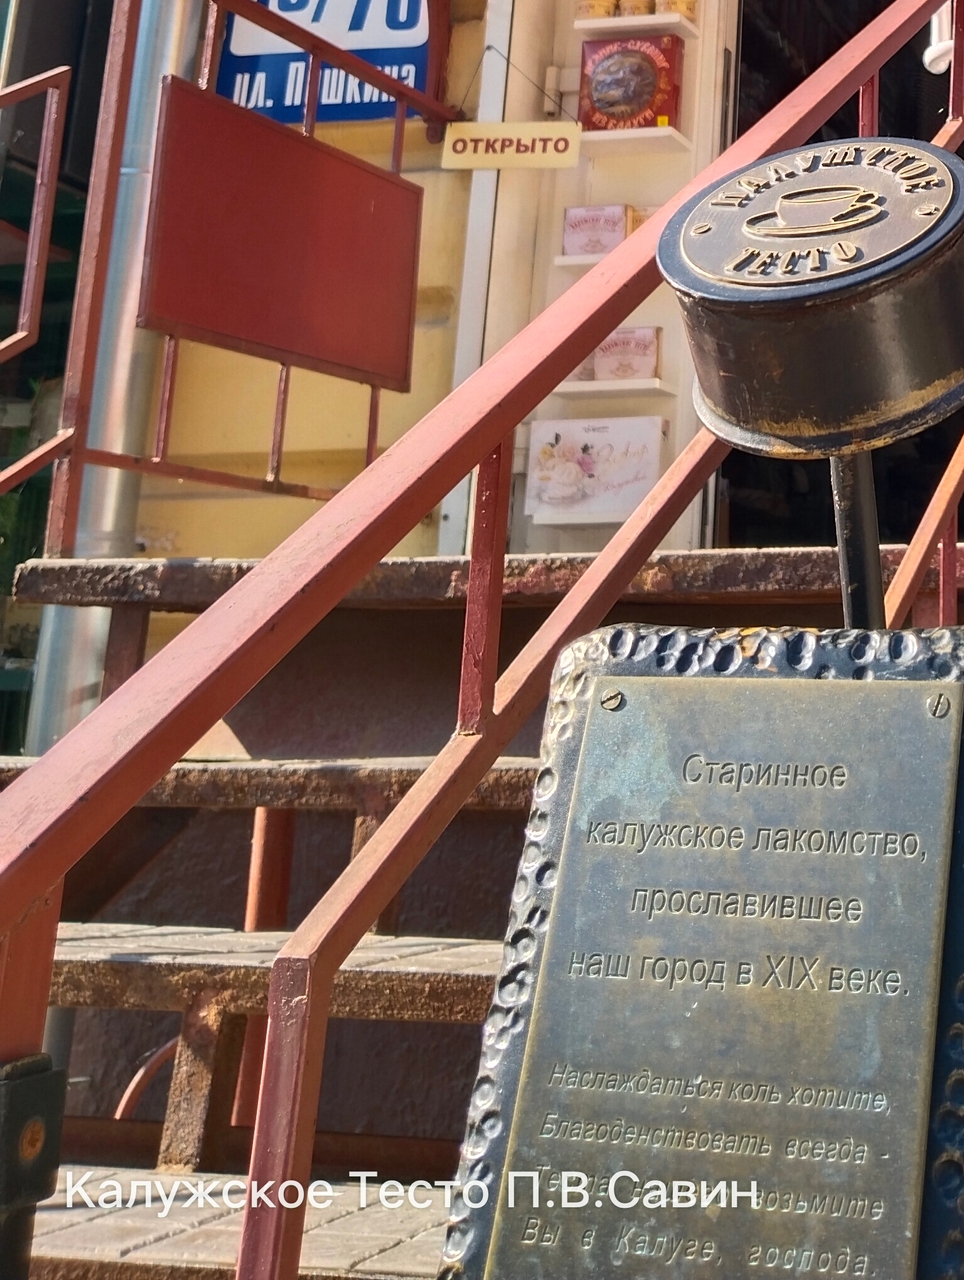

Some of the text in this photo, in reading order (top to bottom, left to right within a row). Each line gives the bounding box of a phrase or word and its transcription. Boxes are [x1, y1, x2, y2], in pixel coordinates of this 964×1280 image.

[284, 62, 417, 108] Пшкина
[452, 136, 570, 156] ОТКРЫТО
[709, 144, 946, 208] КАЛУЖСКОЕ
[724, 239, 859, 275] ТЕСТО
[682, 753, 849, 793] Старинное
[586, 820, 928, 863] калужское лакомство,
[631, 887, 864, 923] прославившее
[568, 950, 911, 997] наш город в XIX веке.
[547, 1063, 892, 1117] Наслаждаться коль хотите,
[539, 1112, 773, 1158] Благоденствовать
[784, 1135, 869, 1165] всегда
[752, 1186, 886, 1222] возьмите
[520, 1216, 878, 1277] Вы в Калуге, господа.
